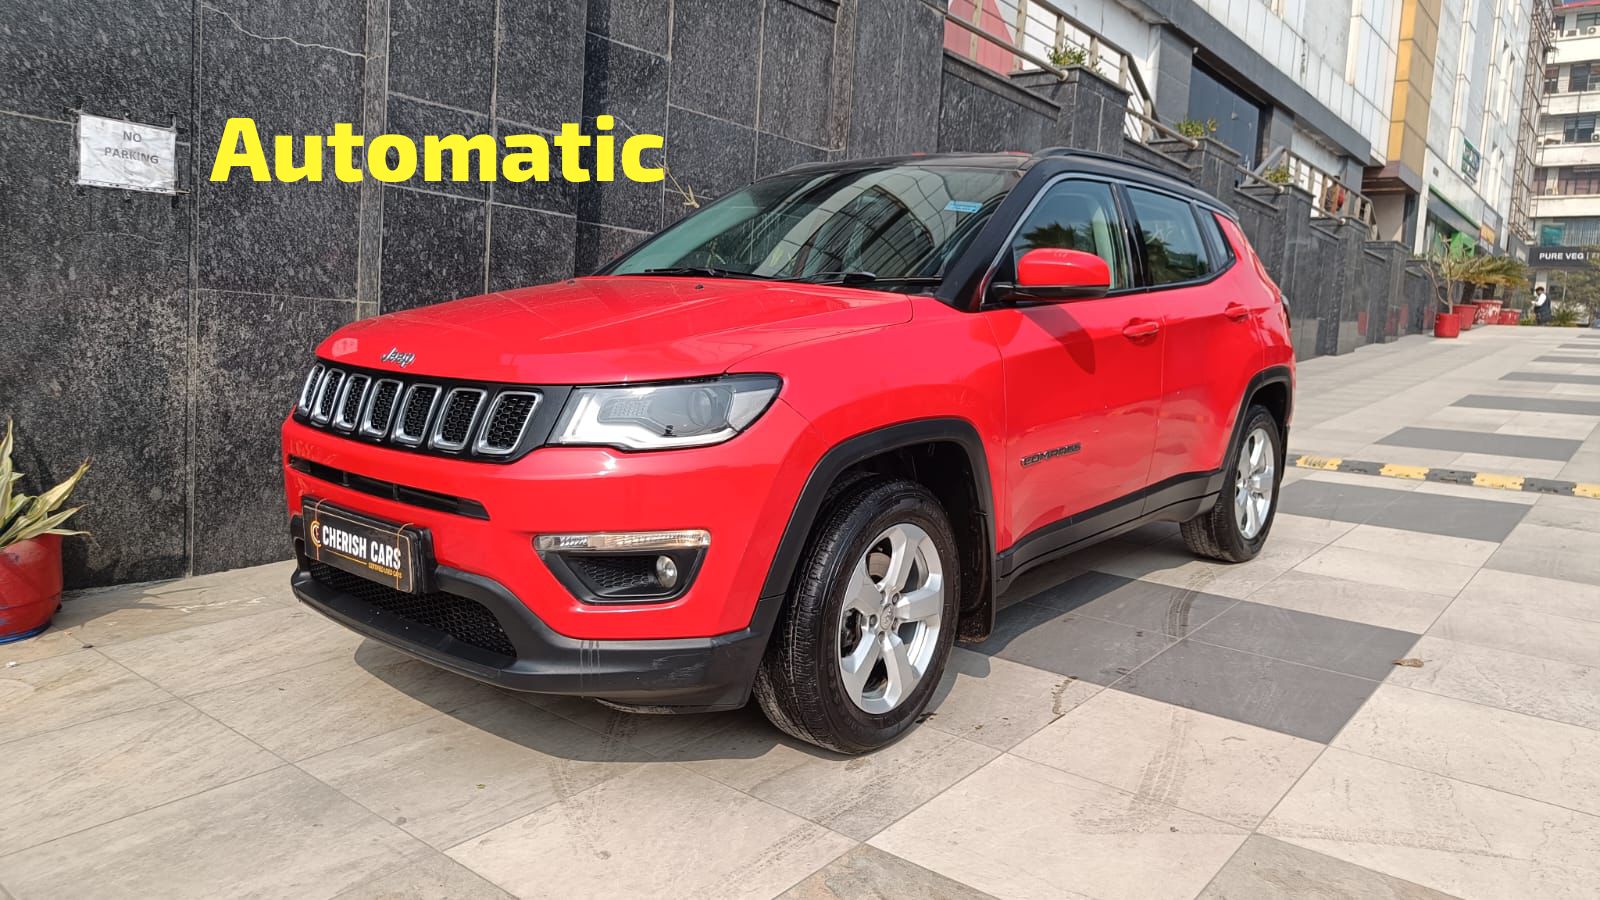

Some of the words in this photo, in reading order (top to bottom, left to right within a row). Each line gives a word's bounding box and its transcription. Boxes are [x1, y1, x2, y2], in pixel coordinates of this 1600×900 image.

[123, 130, 142, 143] NO
[104, 146, 159, 165] PARKING
[1539, 252, 1563, 260] PURE
[1565, 252, 1584, 260] VEG
[381, 347, 415, 368] Jeep
[322, 525, 367, 559] CHERISH
[370, 541, 401, 570] CARS
